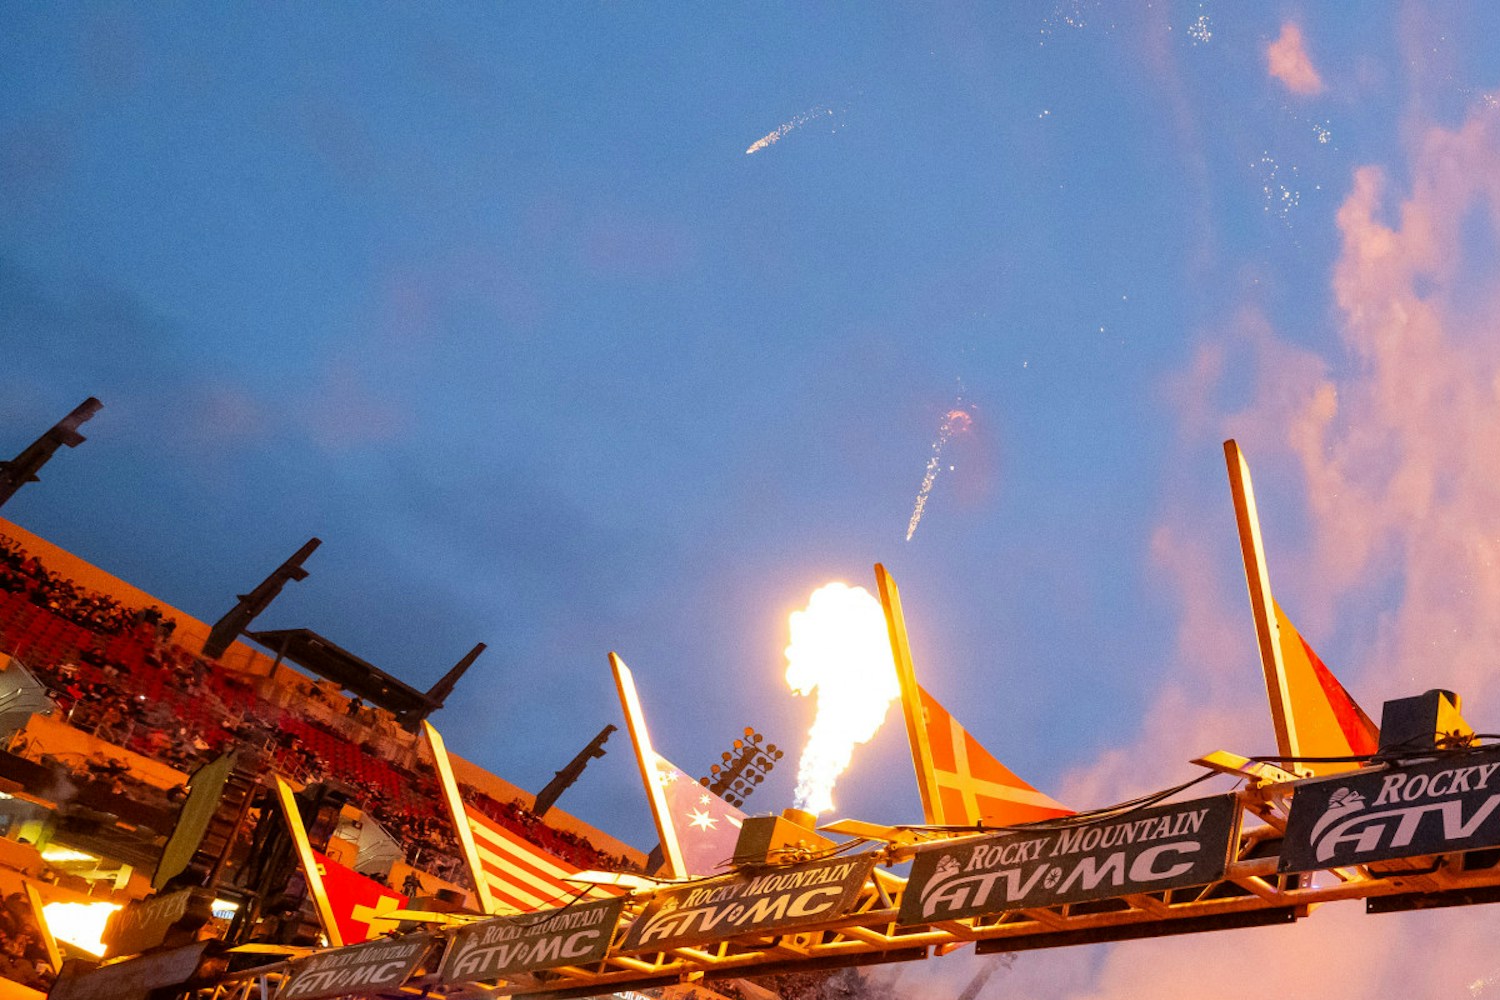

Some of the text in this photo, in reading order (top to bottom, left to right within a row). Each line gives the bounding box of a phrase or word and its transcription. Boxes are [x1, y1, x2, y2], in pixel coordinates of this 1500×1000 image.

[1372, 761, 1500, 806] ROCKY
[964, 809, 1209, 872] ROCKY MOUNTAIN
[680, 862, 857, 909] ROCKY MOUNTAIN
[523, 907, 609, 937] MOUNTAIN
